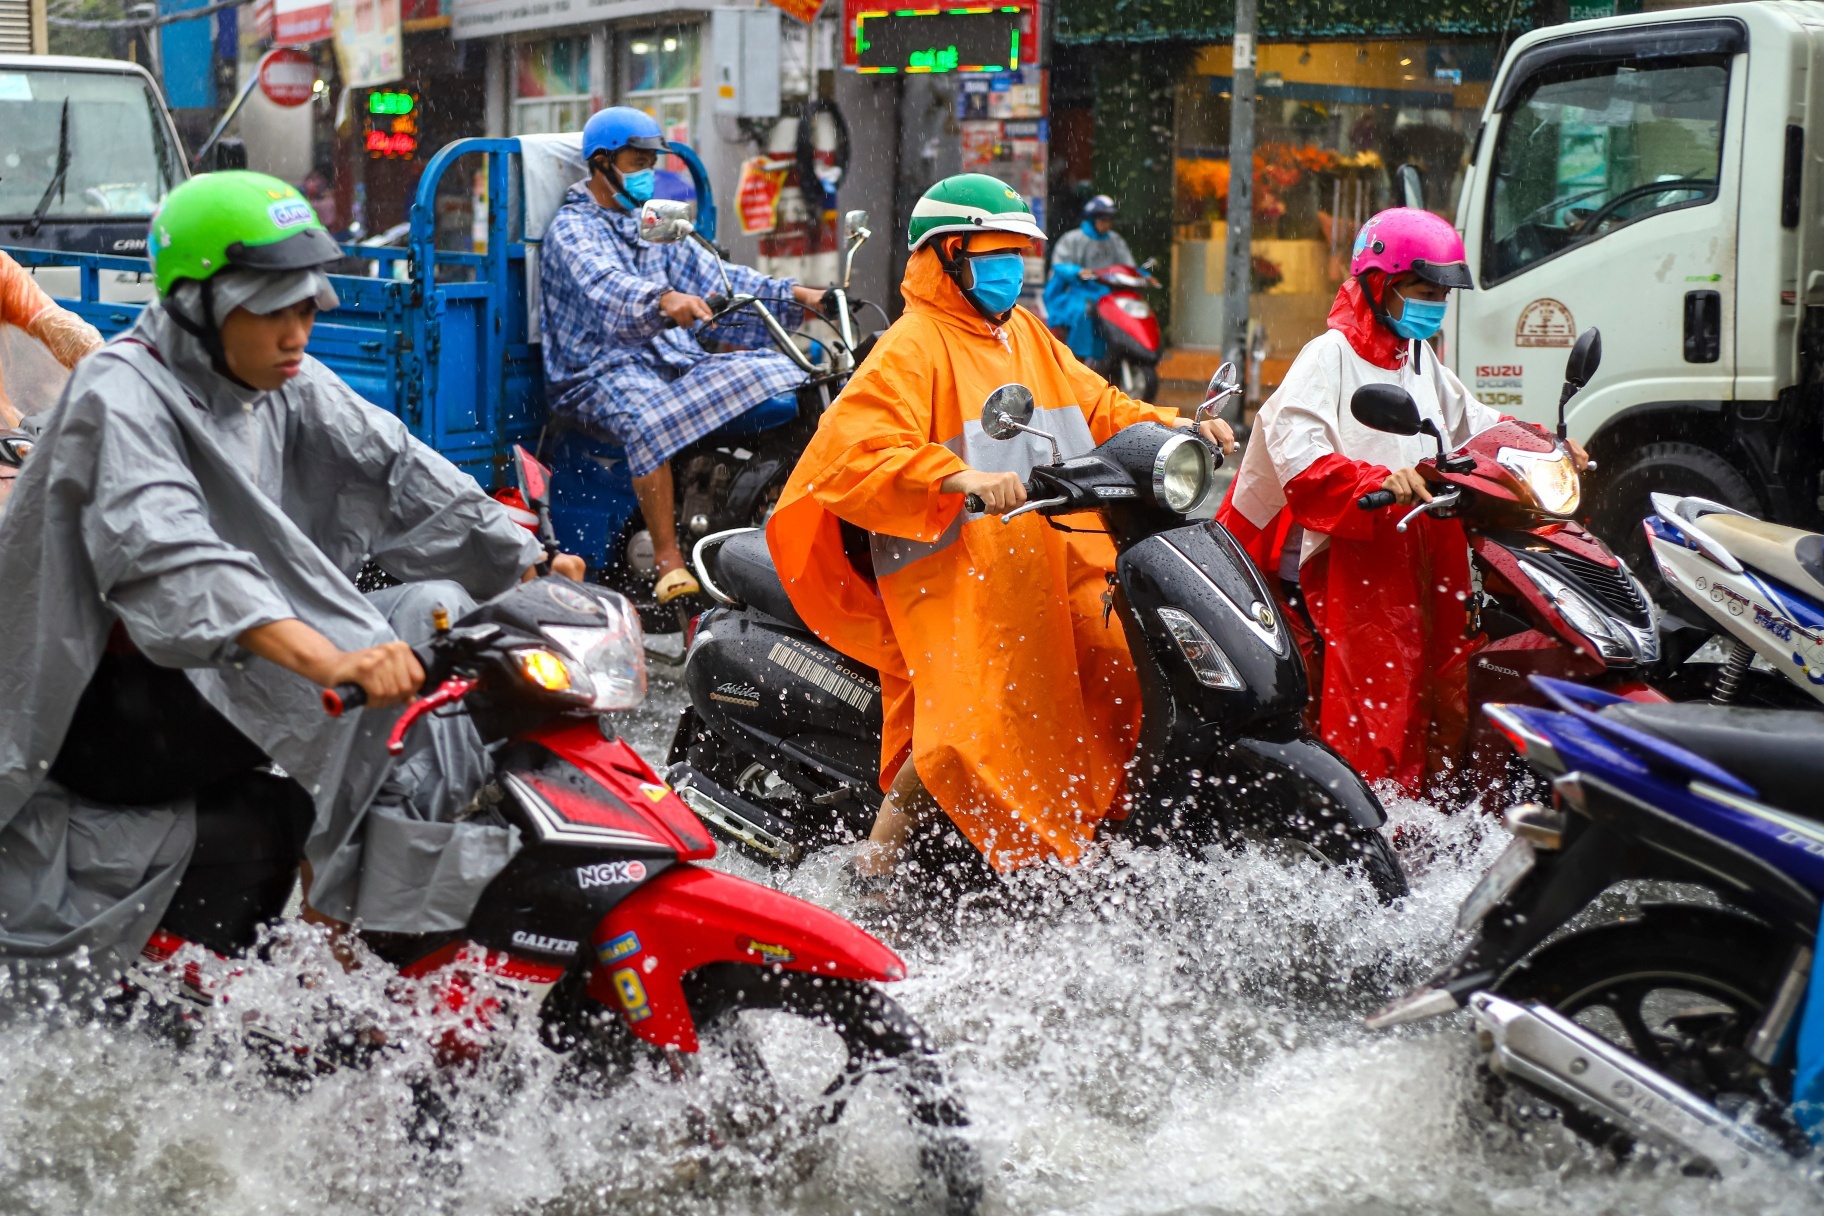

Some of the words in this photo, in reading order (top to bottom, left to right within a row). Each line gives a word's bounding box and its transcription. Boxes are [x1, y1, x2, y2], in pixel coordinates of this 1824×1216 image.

[369, 91, 413, 114] LED
[113, 238, 148, 251] CAN
[1475, 365, 1523, 377] ISUZU
[1478, 661, 1520, 677] HONDA
[577, 860, 630, 889] NGK
[512, 930, 579, 953] GALFER
